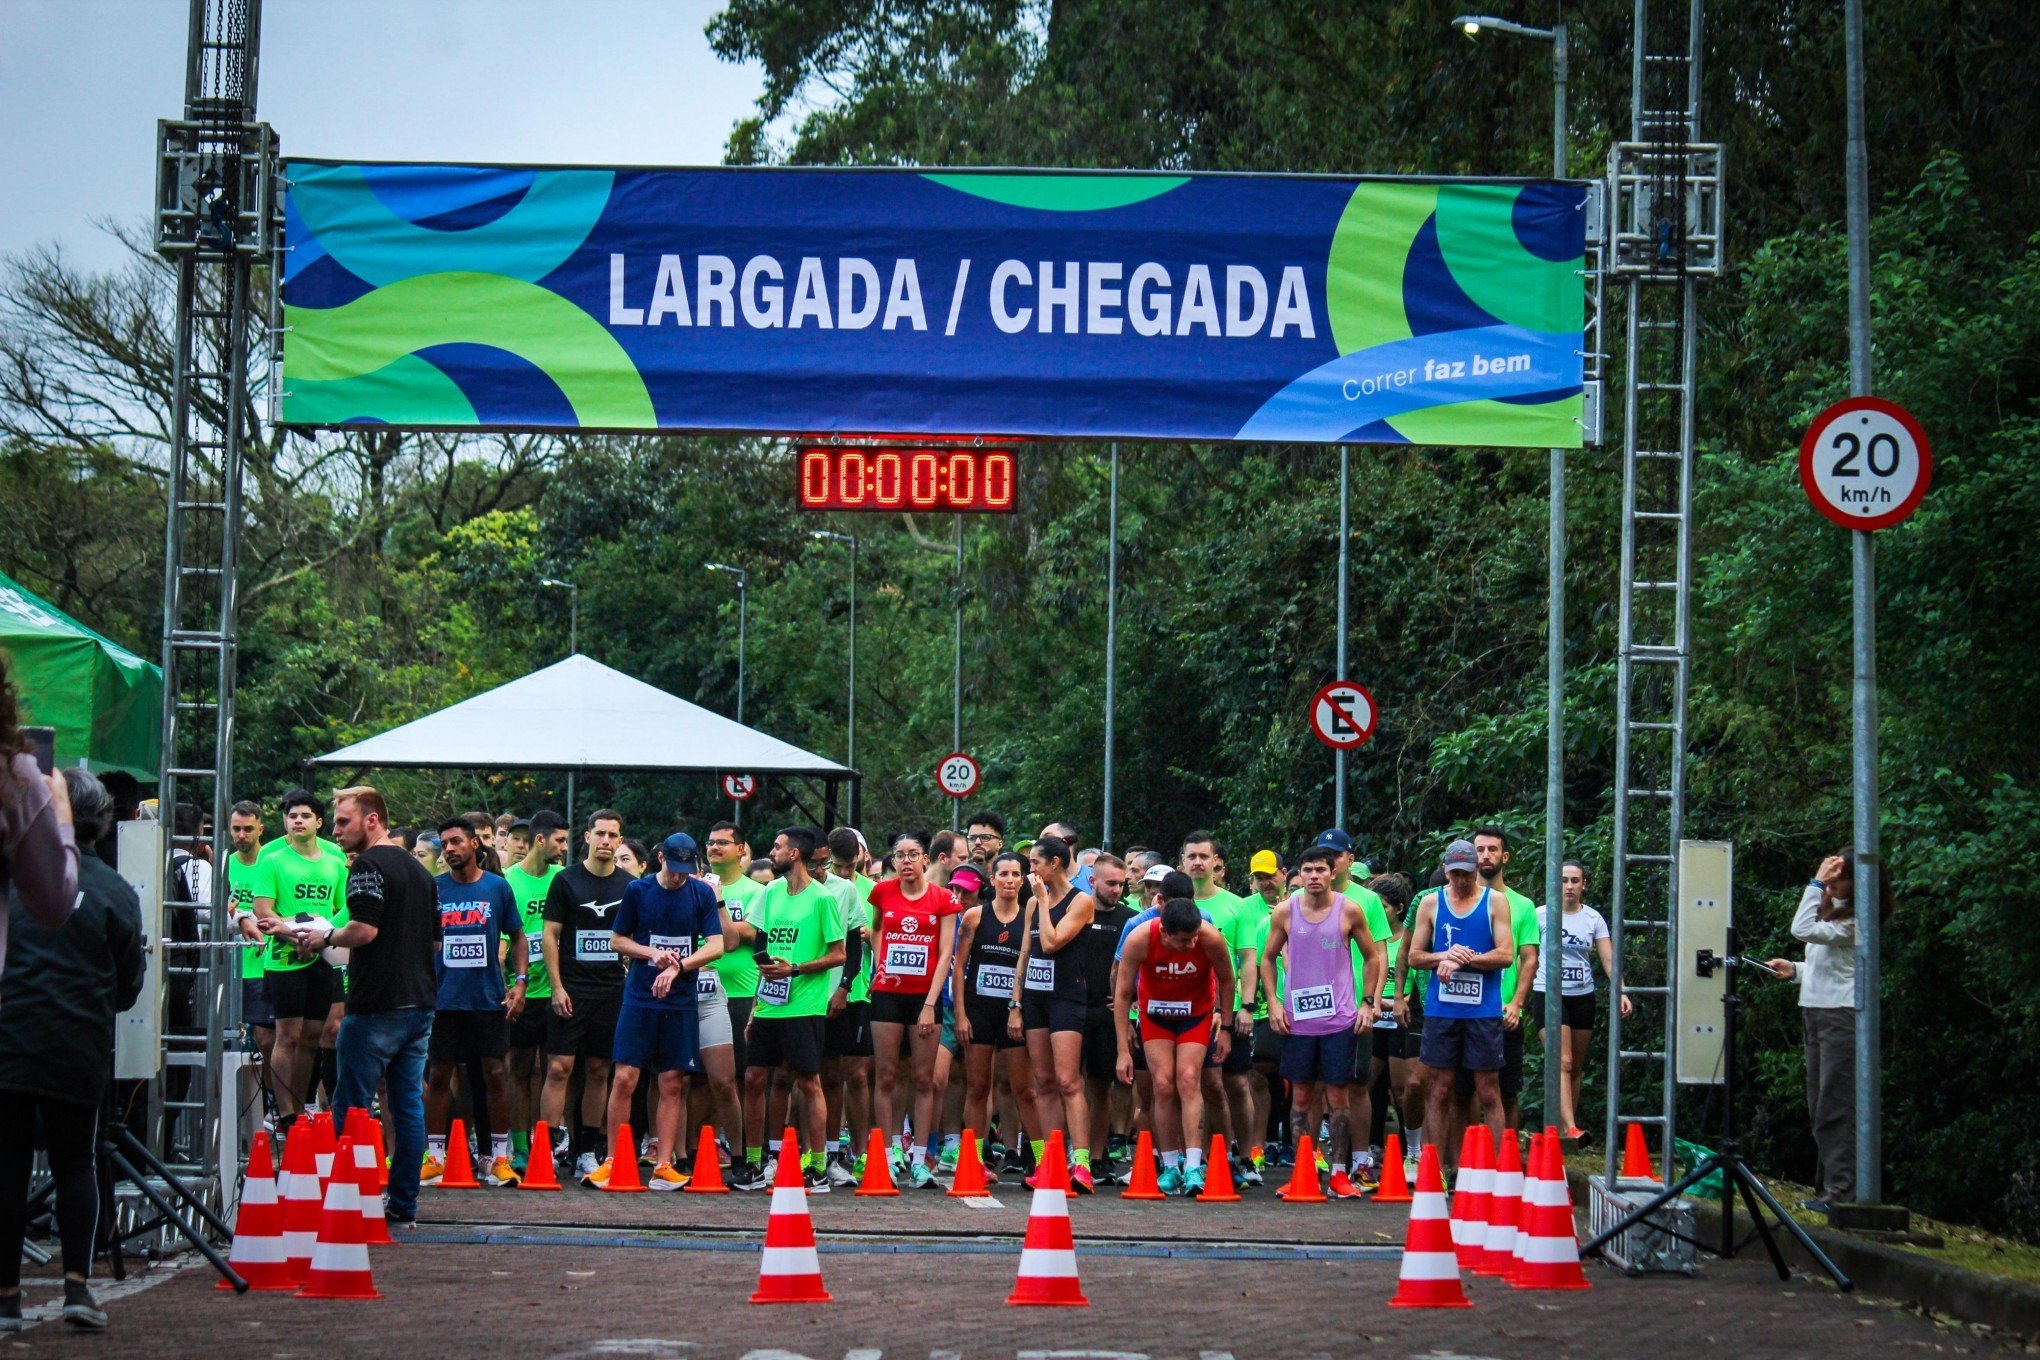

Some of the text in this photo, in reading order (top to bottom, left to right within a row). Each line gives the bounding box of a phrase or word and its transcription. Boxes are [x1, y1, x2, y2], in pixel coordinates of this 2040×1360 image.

[608, 252, 1316, 339] LARGADA / CHEGADA
[1342, 353, 1532, 401] Correr faz bem
[1831, 431, 1900, 478] 20
[803, 453, 1011, 505] 00:00:00
[1840, 485, 1891, 503] km/h
[946, 764, 970, 780] 20
[230, 889, 255, 904] SES
[294, 883, 333, 901] SESI
[526, 899, 546, 916] SE
[768, 927, 800, 944] SESI
[885, 931, 936, 943] percorrer
[451, 945, 484, 958] 6053
[981, 944, 1012, 953] FERNANDO
[893, 952, 925, 965] 3197
[1155, 961, 1198, 975] FILA
[1562, 968, 1583, 980] 216
[985, 974, 1014, 987] 3038
[1448, 980, 1479, 995] 3085
[763, 981, 787, 997] 3295
[1300, 994, 1331, 1011] 3297
